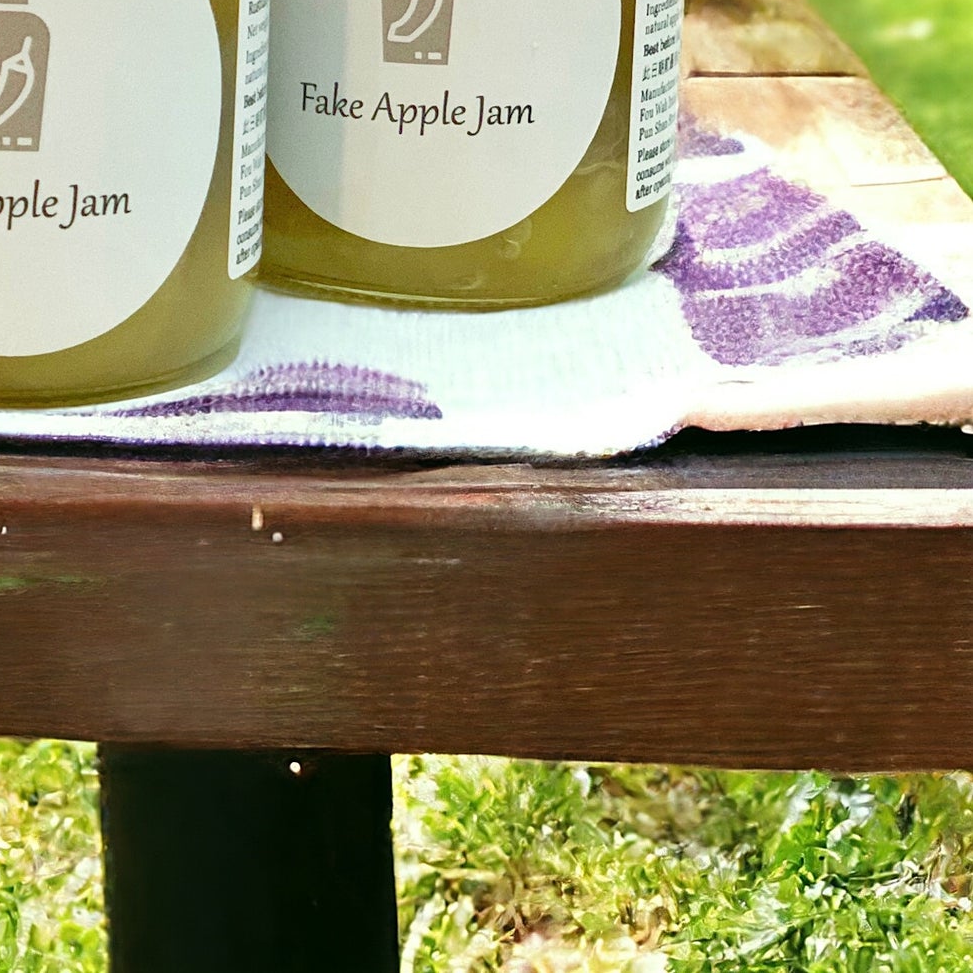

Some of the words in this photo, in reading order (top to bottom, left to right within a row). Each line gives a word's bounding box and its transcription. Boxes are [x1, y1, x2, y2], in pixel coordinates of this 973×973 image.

[644, 14, 669, 36] natural
[643, 41, 659, 57] Best
[299, 81, 364, 120] Fake
[370, 89, 467, 137] Apple
[466, 94, 536, 137] Jam
[637, 144, 659, 163] Please
[635, 181, 653, 200] after
[58, 184, 132, 230] Jam
